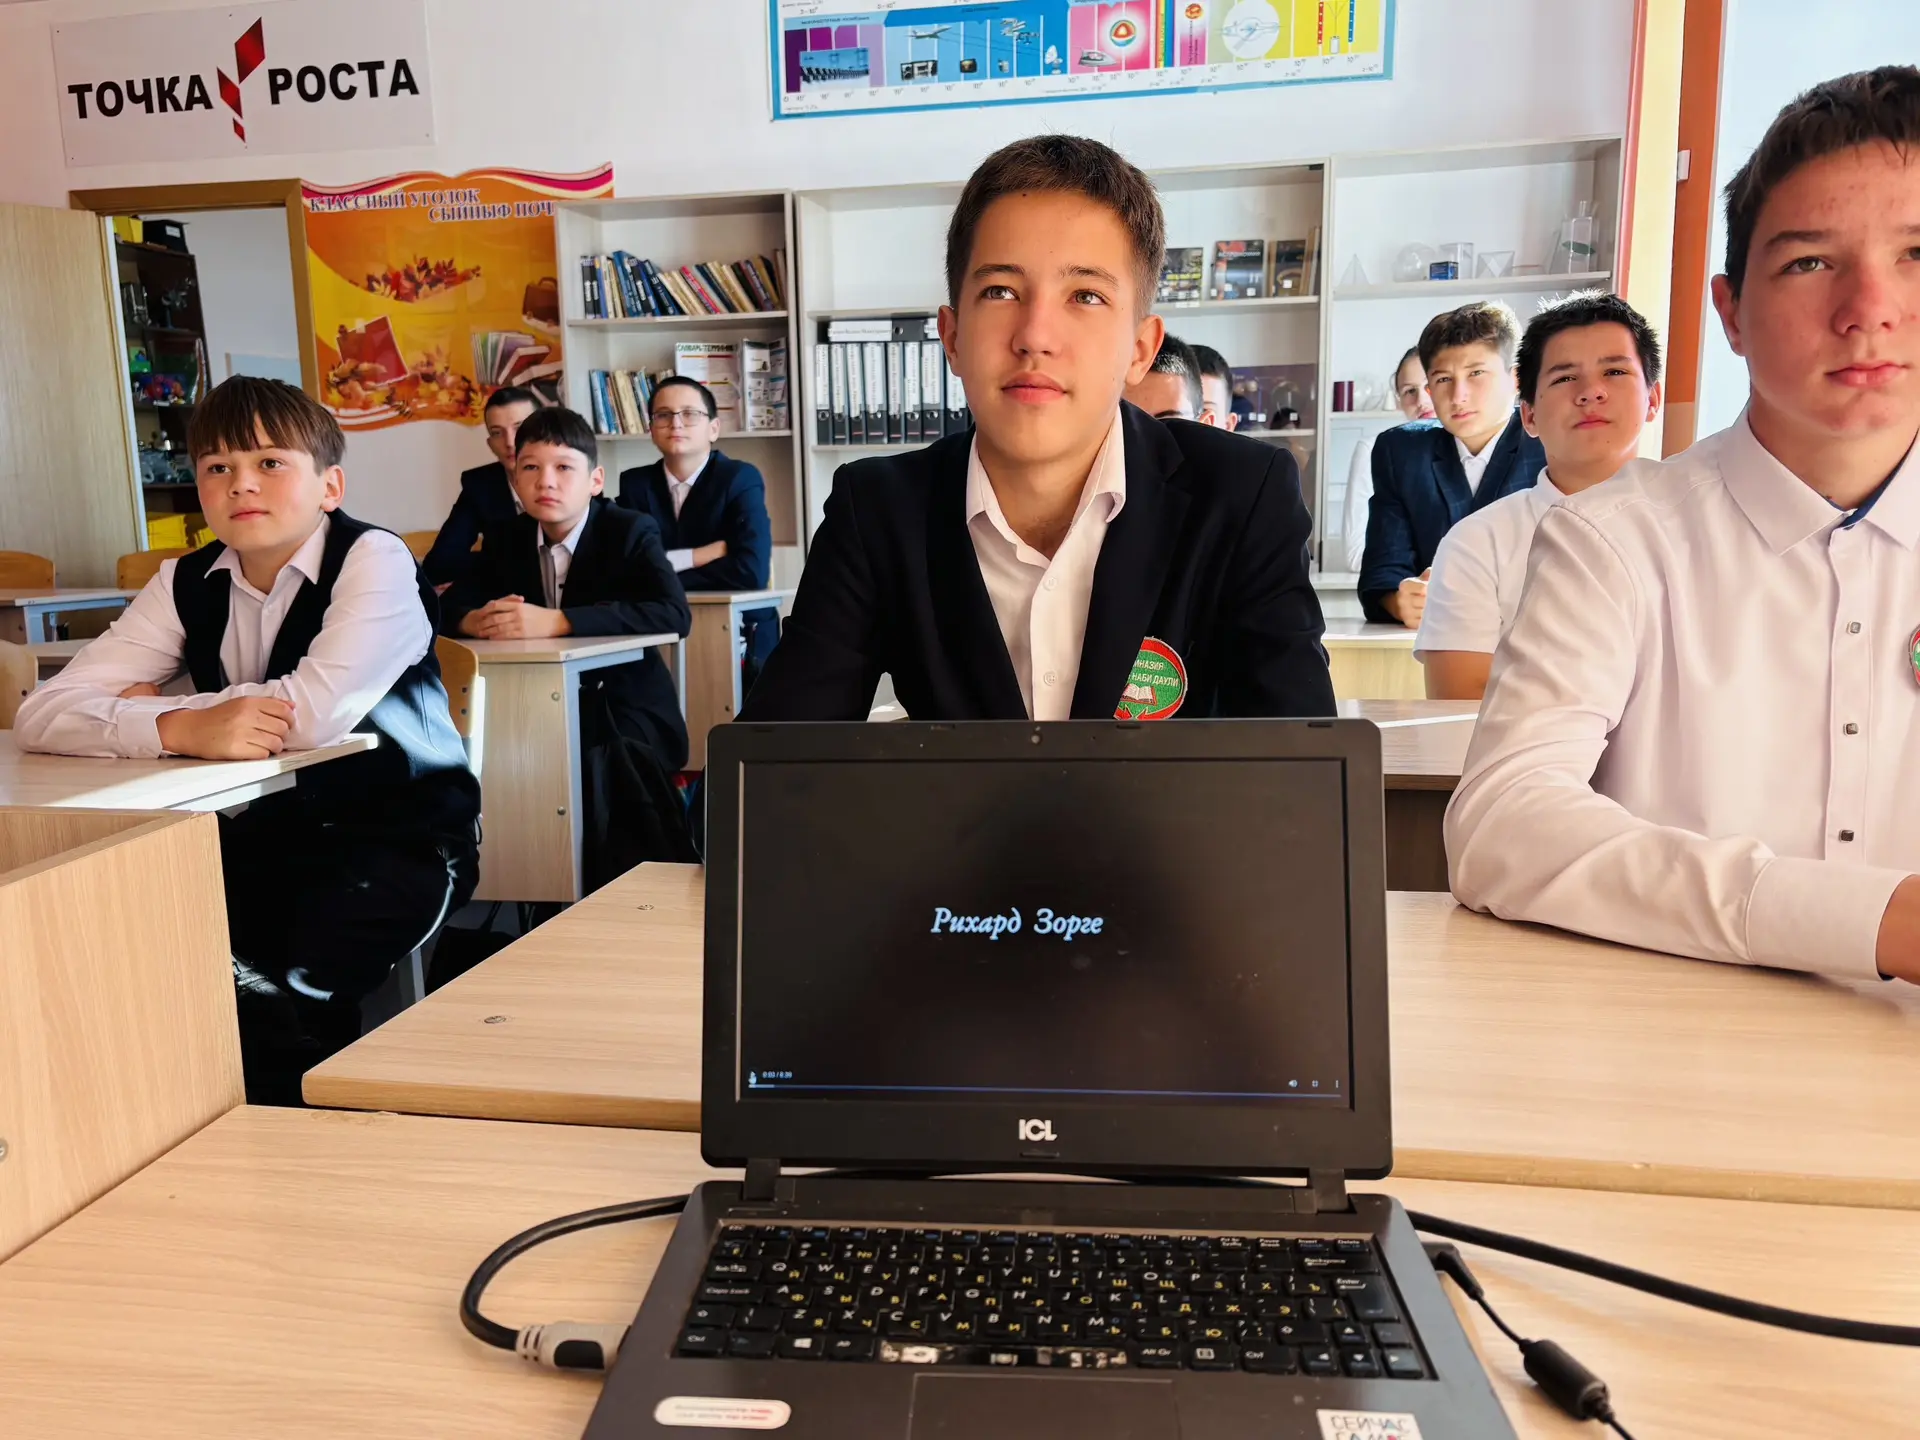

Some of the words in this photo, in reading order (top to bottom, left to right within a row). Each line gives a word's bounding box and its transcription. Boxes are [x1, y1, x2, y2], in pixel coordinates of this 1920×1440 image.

[67, 74, 214, 119] ТОЧКА
[268, 59, 420, 105] РОСТА
[310, 189, 404, 212] КЛАССНЫЙ
[410, 189, 480, 207] УГОЛОК
[428, 203, 511, 222] СЫЙНЫФ
[930, 907, 1022, 940] Рихард
[1033, 908, 1104, 941] Зорге
[1019, 1118, 1058, 1141] ICL
